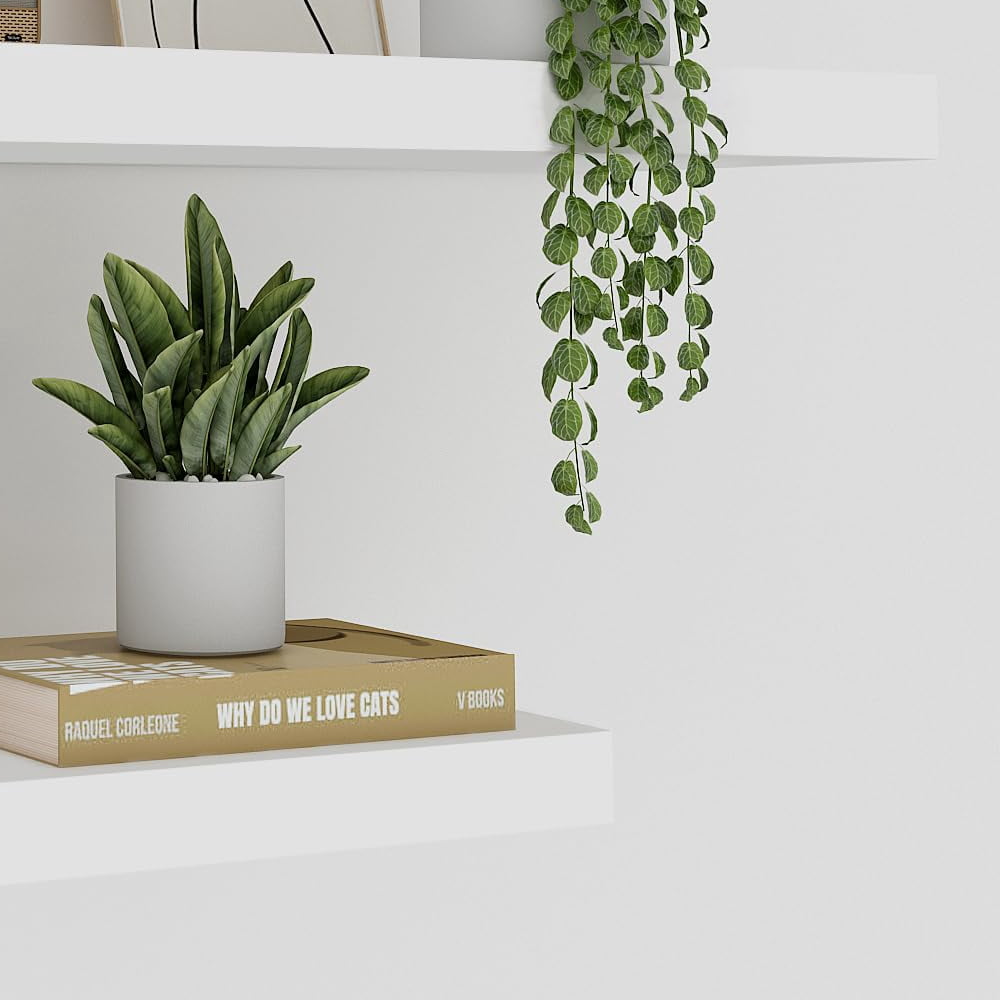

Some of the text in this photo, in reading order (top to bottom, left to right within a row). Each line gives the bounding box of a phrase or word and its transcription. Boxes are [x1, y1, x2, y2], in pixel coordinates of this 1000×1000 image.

[216, 689, 400, 729] WHY DO WE LOVE CATS
[457, 687, 505, 710] V BOOKS
[64, 713, 180, 742] RAQUEL CORLEONE
